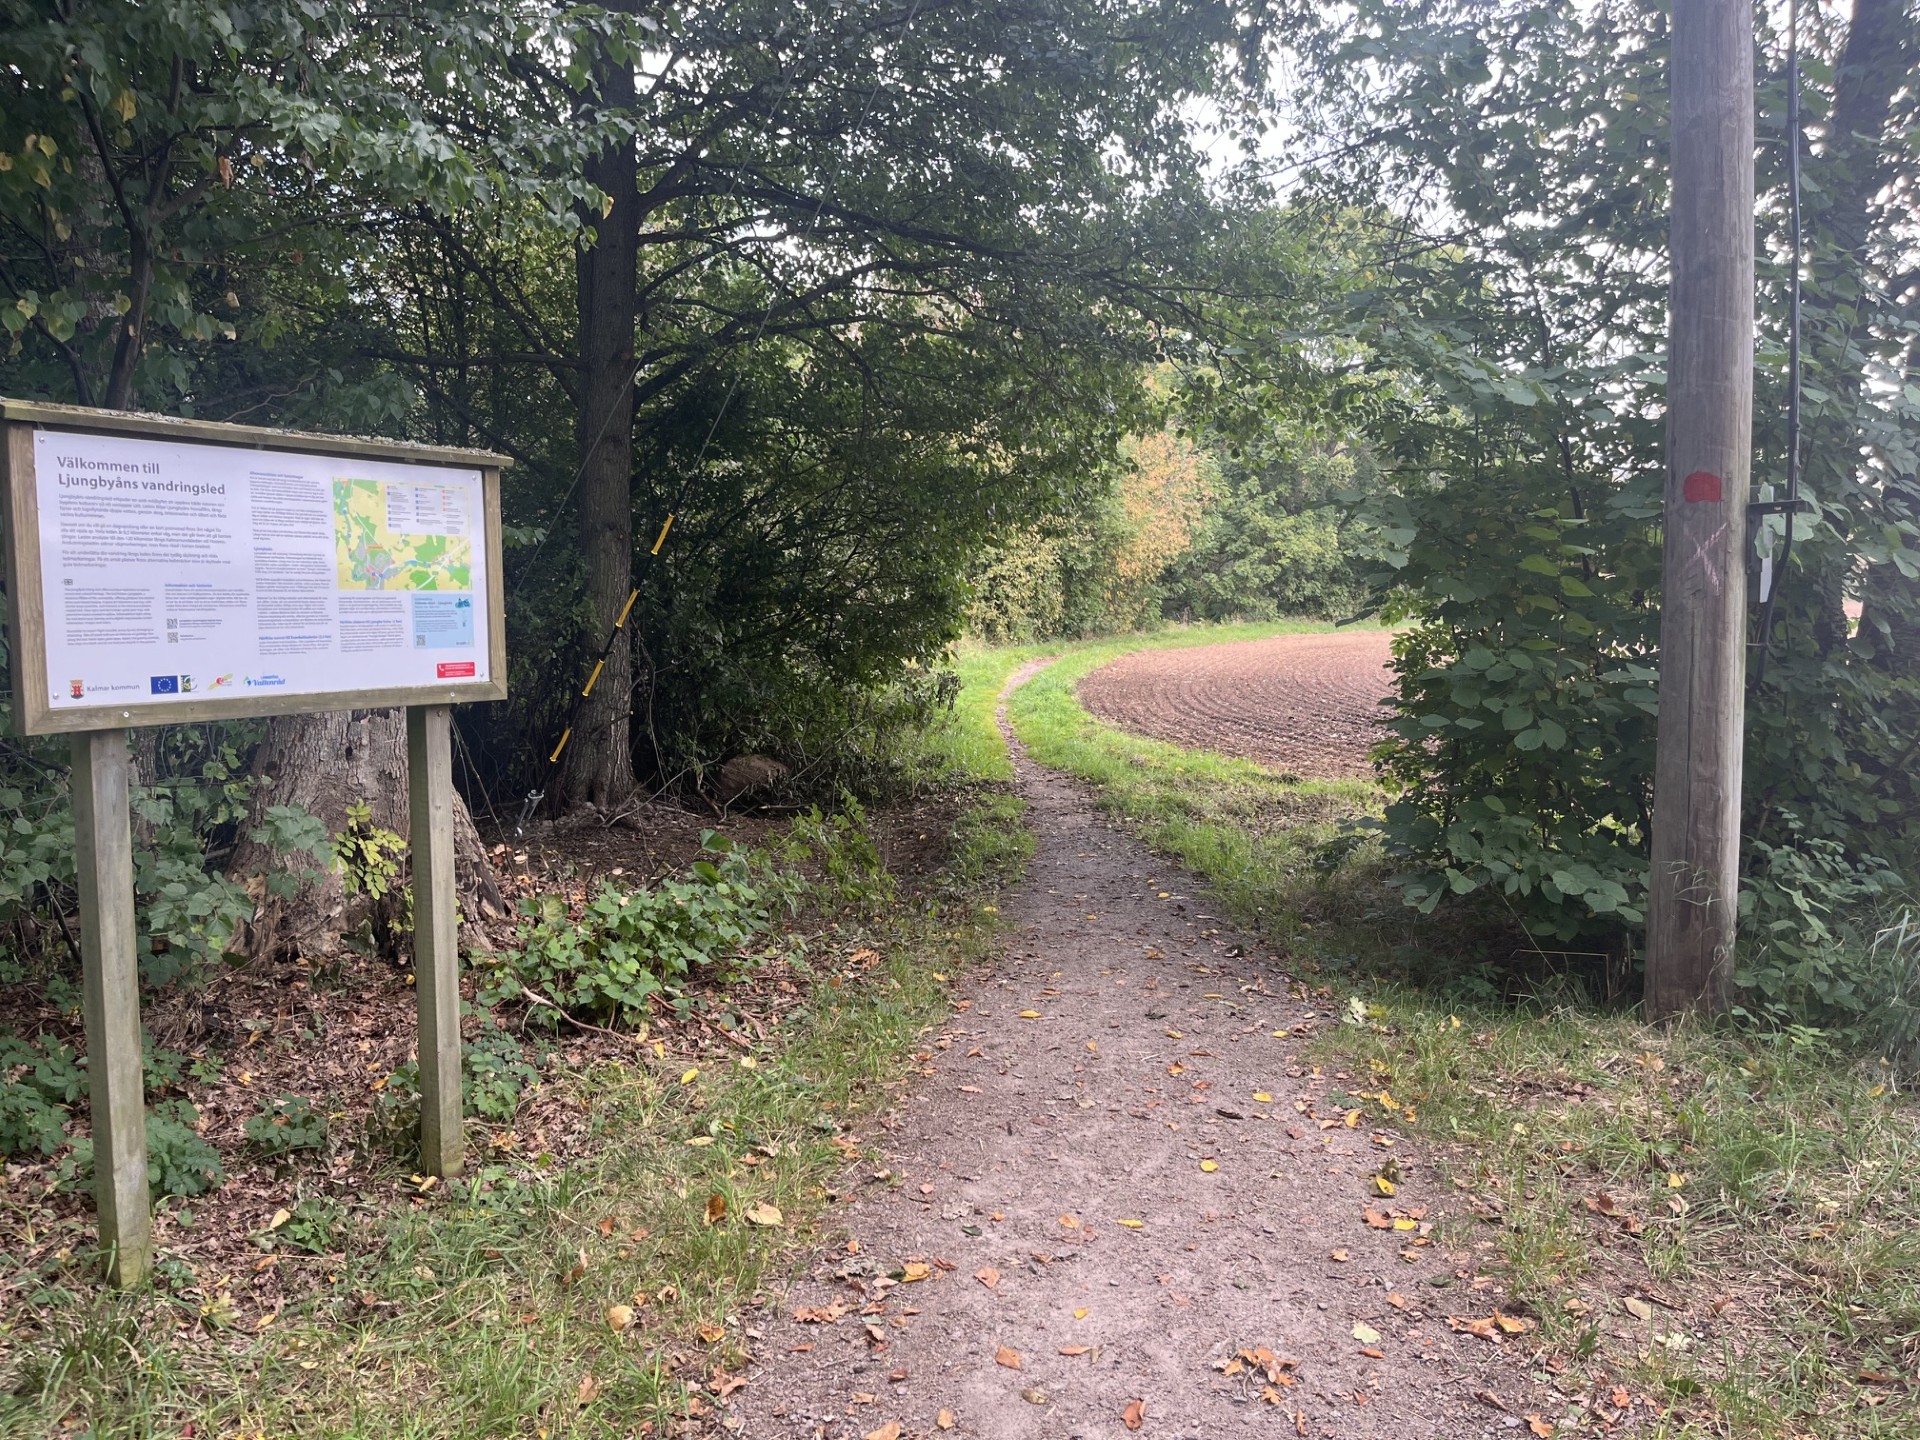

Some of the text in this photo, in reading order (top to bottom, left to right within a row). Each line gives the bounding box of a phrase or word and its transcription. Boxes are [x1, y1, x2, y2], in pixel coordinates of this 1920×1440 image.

[57, 456, 160, 474] Välkommen till
[58, 473, 225, 495] Ljungbyåns vandringsled
